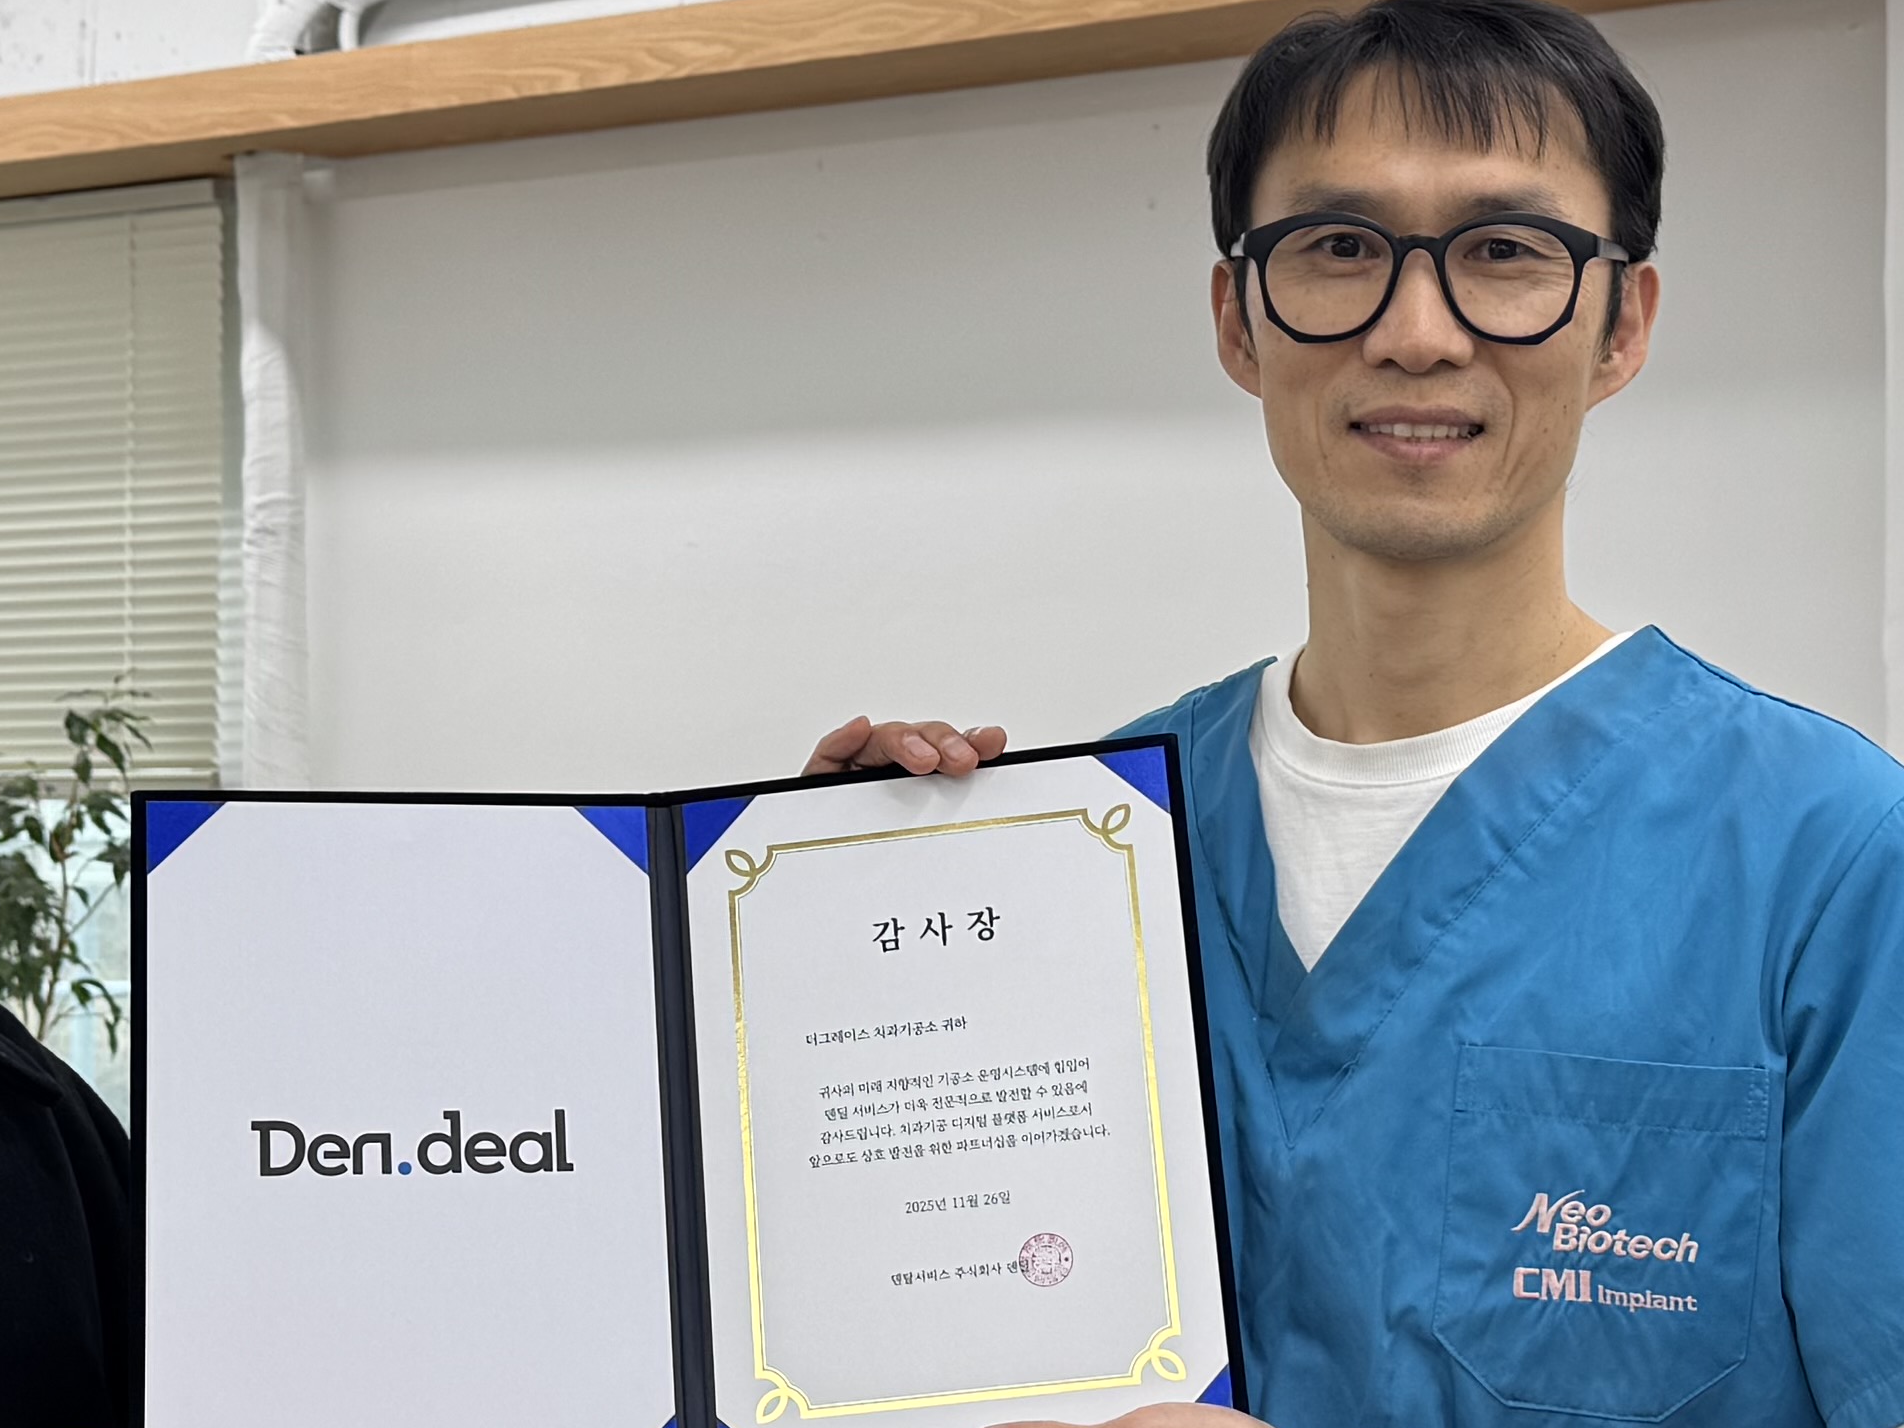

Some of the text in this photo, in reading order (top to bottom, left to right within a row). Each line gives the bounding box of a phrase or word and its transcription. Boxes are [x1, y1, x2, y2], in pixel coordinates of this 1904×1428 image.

[874, 1021, 939, 1039] 치과기공소
[942, 1015, 968, 1032] 귀하
[858, 1080, 882, 1094] 미래
[937, 1072, 975, 1087] 기공소
[852, 1101, 900, 1118] 서비스가
[1036, 1085, 1048, 1098] 수
[900, 1119, 948, 1136] 치과기공
[905, 1190, 1011, 1214] 2025년 11월 26일
[1511, 1189, 1612, 1234] Neo
[1553, 1222, 1699, 1264] Biotech
[1512, 1267, 1698, 1313] CMI Implant
